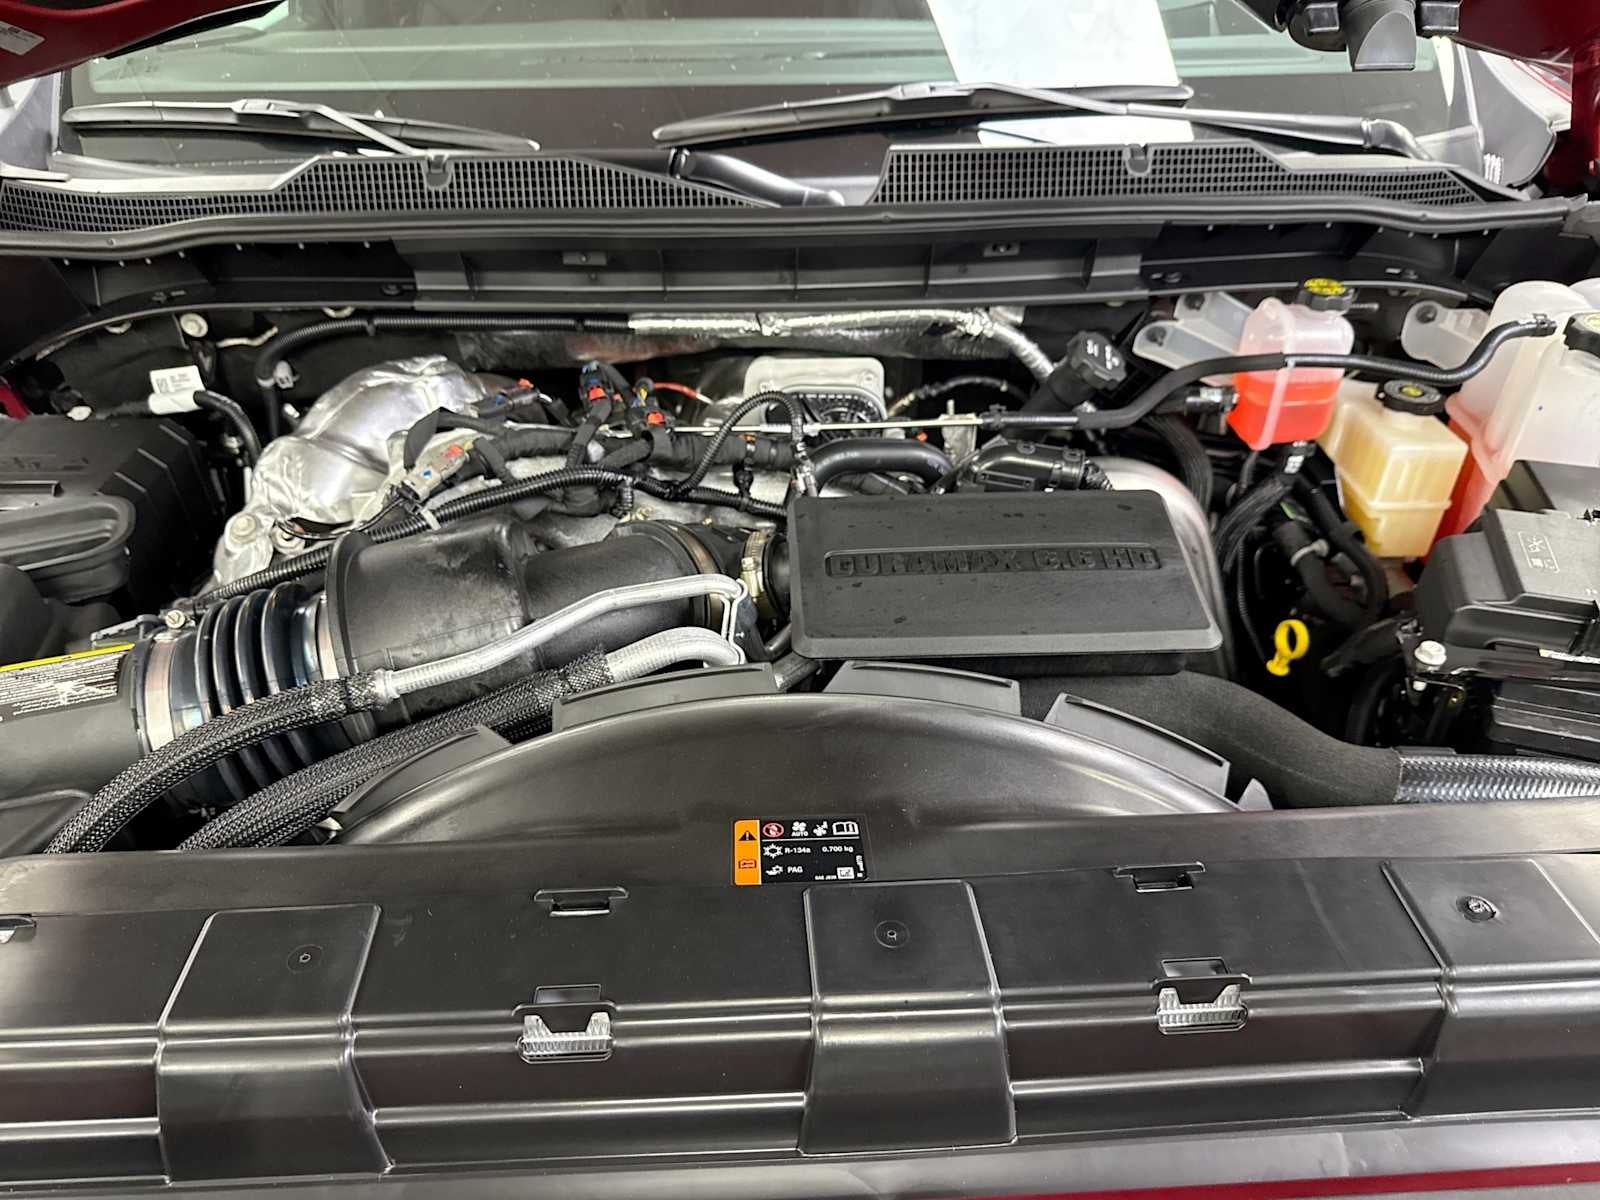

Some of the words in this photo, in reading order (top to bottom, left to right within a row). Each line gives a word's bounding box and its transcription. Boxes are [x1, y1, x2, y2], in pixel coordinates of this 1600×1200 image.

[829, 548, 1023, 577] DURAMAX
[843, 845, 854, 853] kg
[787, 865, 804, 874] PAG
